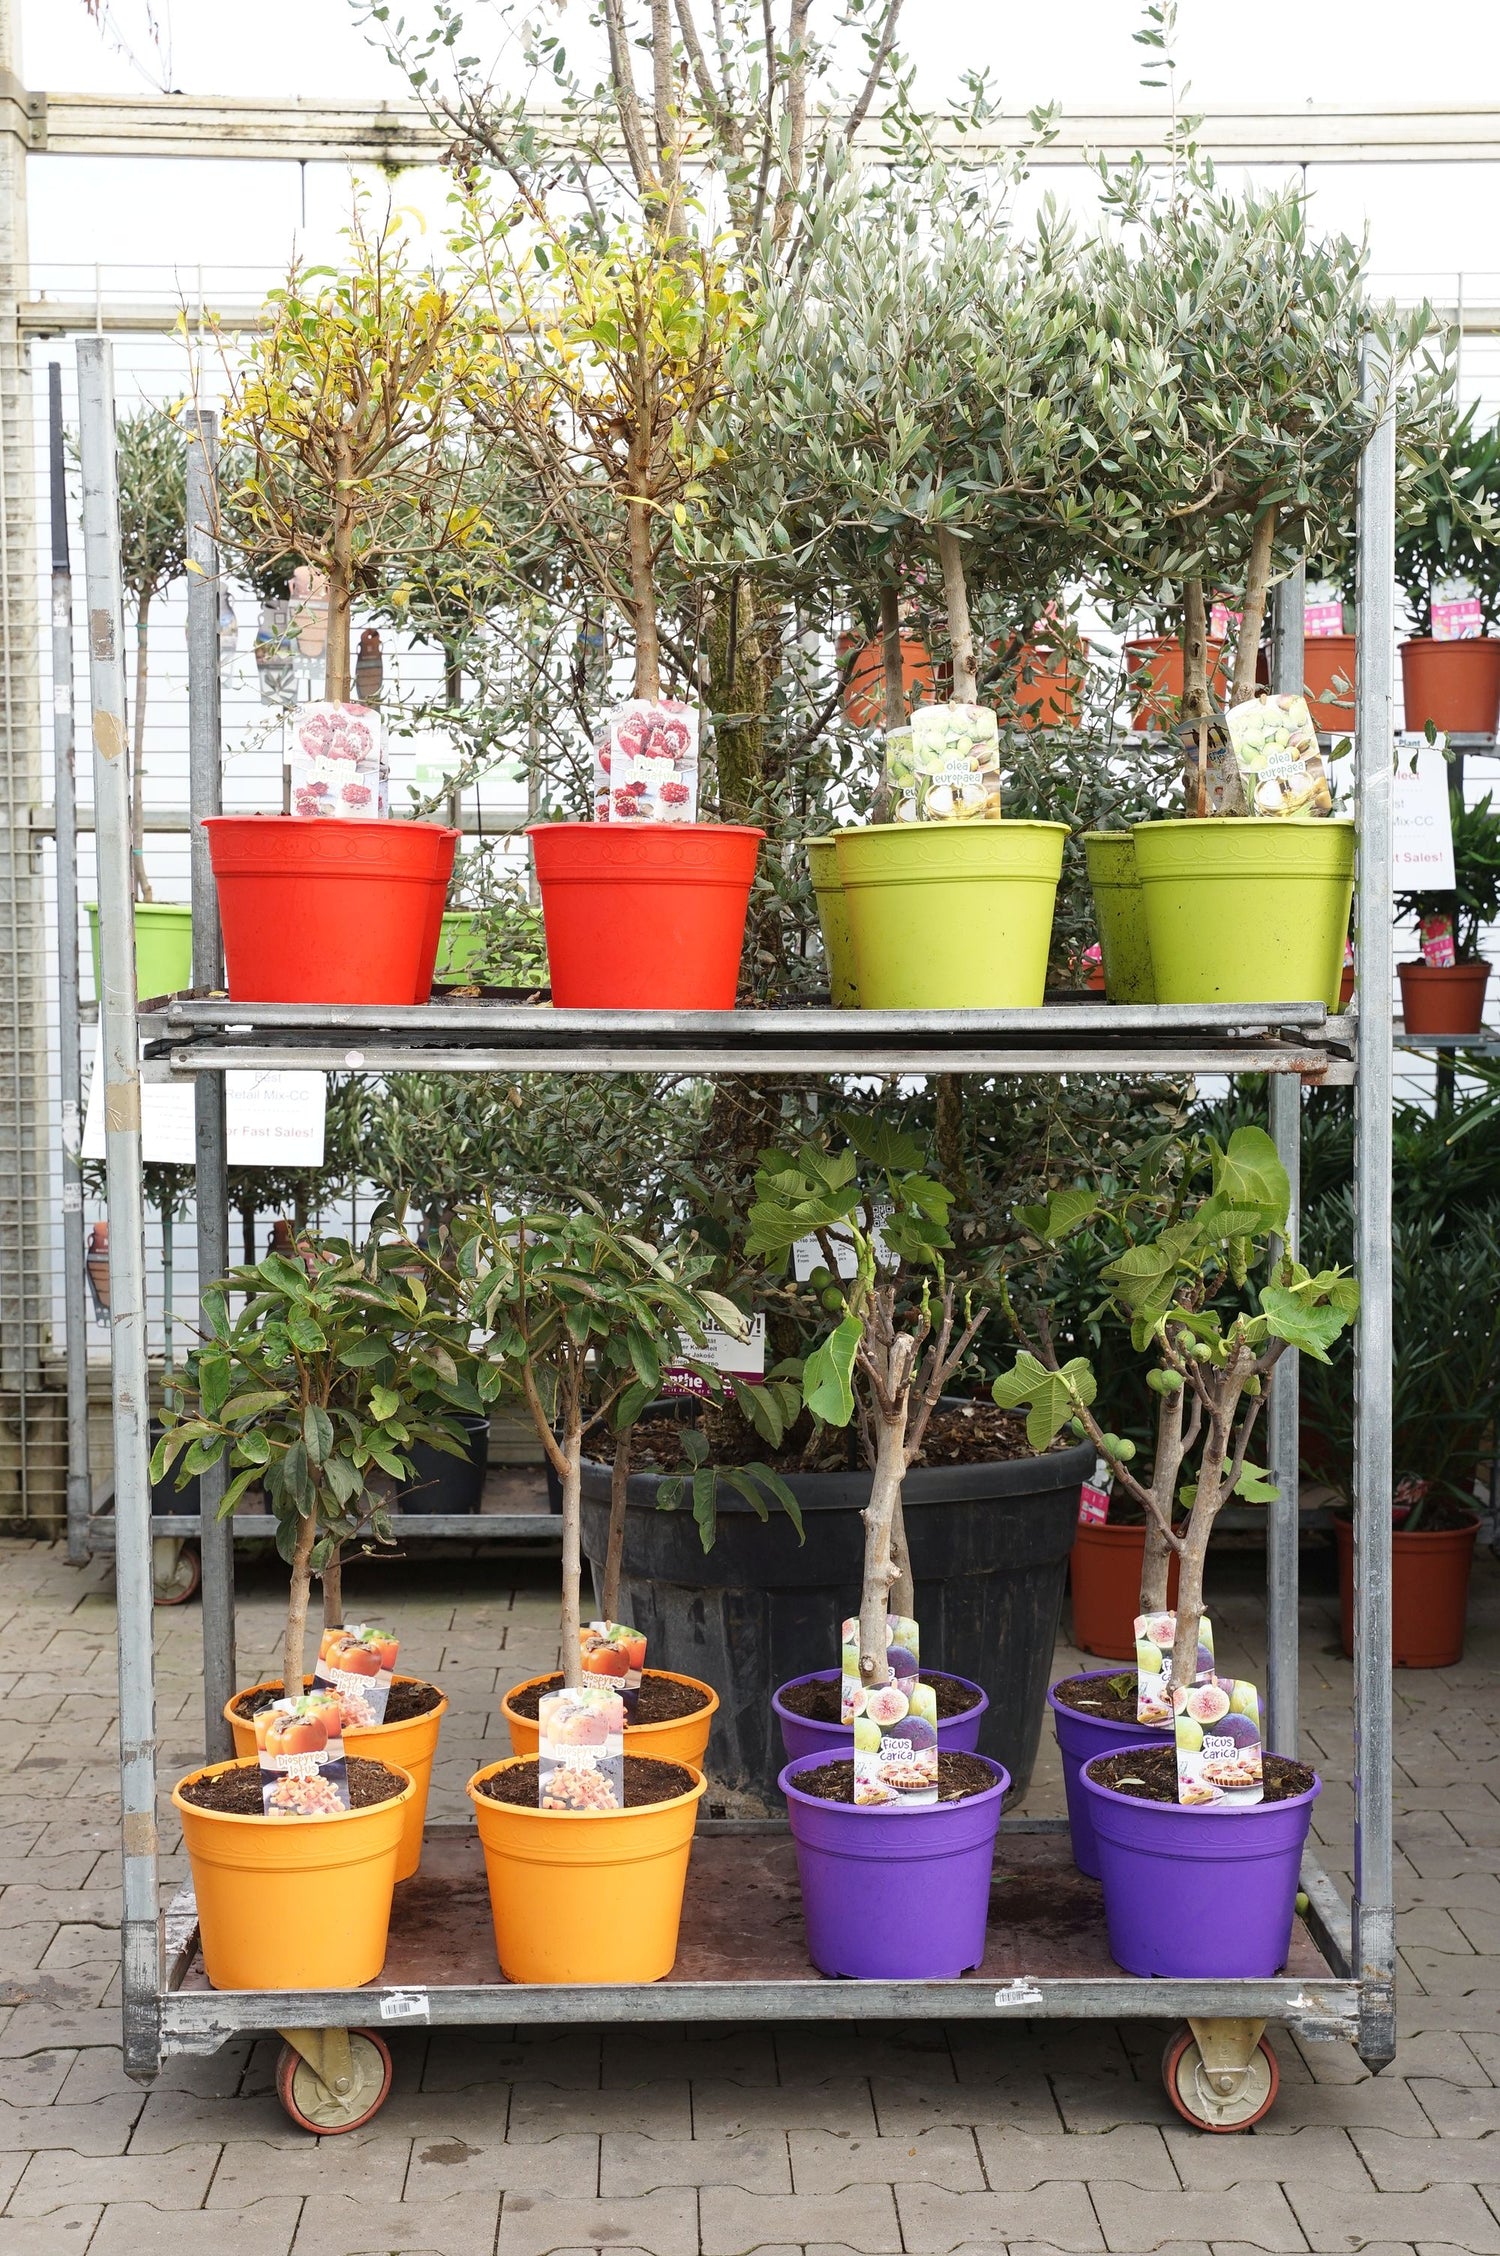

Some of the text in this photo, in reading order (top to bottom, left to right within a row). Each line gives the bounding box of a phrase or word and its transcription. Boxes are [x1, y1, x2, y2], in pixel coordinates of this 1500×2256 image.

[1260, 761, 1304, 779] europaea
[934, 773, 981, 786] europaea
[1403, 851, 1443, 863] Sales!
[227, 1089, 310, 1101] Retail Mix-CC
[242, 1126, 271, 1137] Fast
[274, 1126, 314, 1138] Sales!
[331, 1669, 375, 1686] Diospyros
[338, 1680, 363, 1695] lotus
[557, 1745, 605, 1758] Diospyros
[879, 1750, 913, 1761] carica
[1202, 1748, 1236, 1760] carica
[278, 1752, 326, 1766] Diospyros
[567, 1756, 595, 1770] lotus
[289, 1765, 317, 1778] lotus
